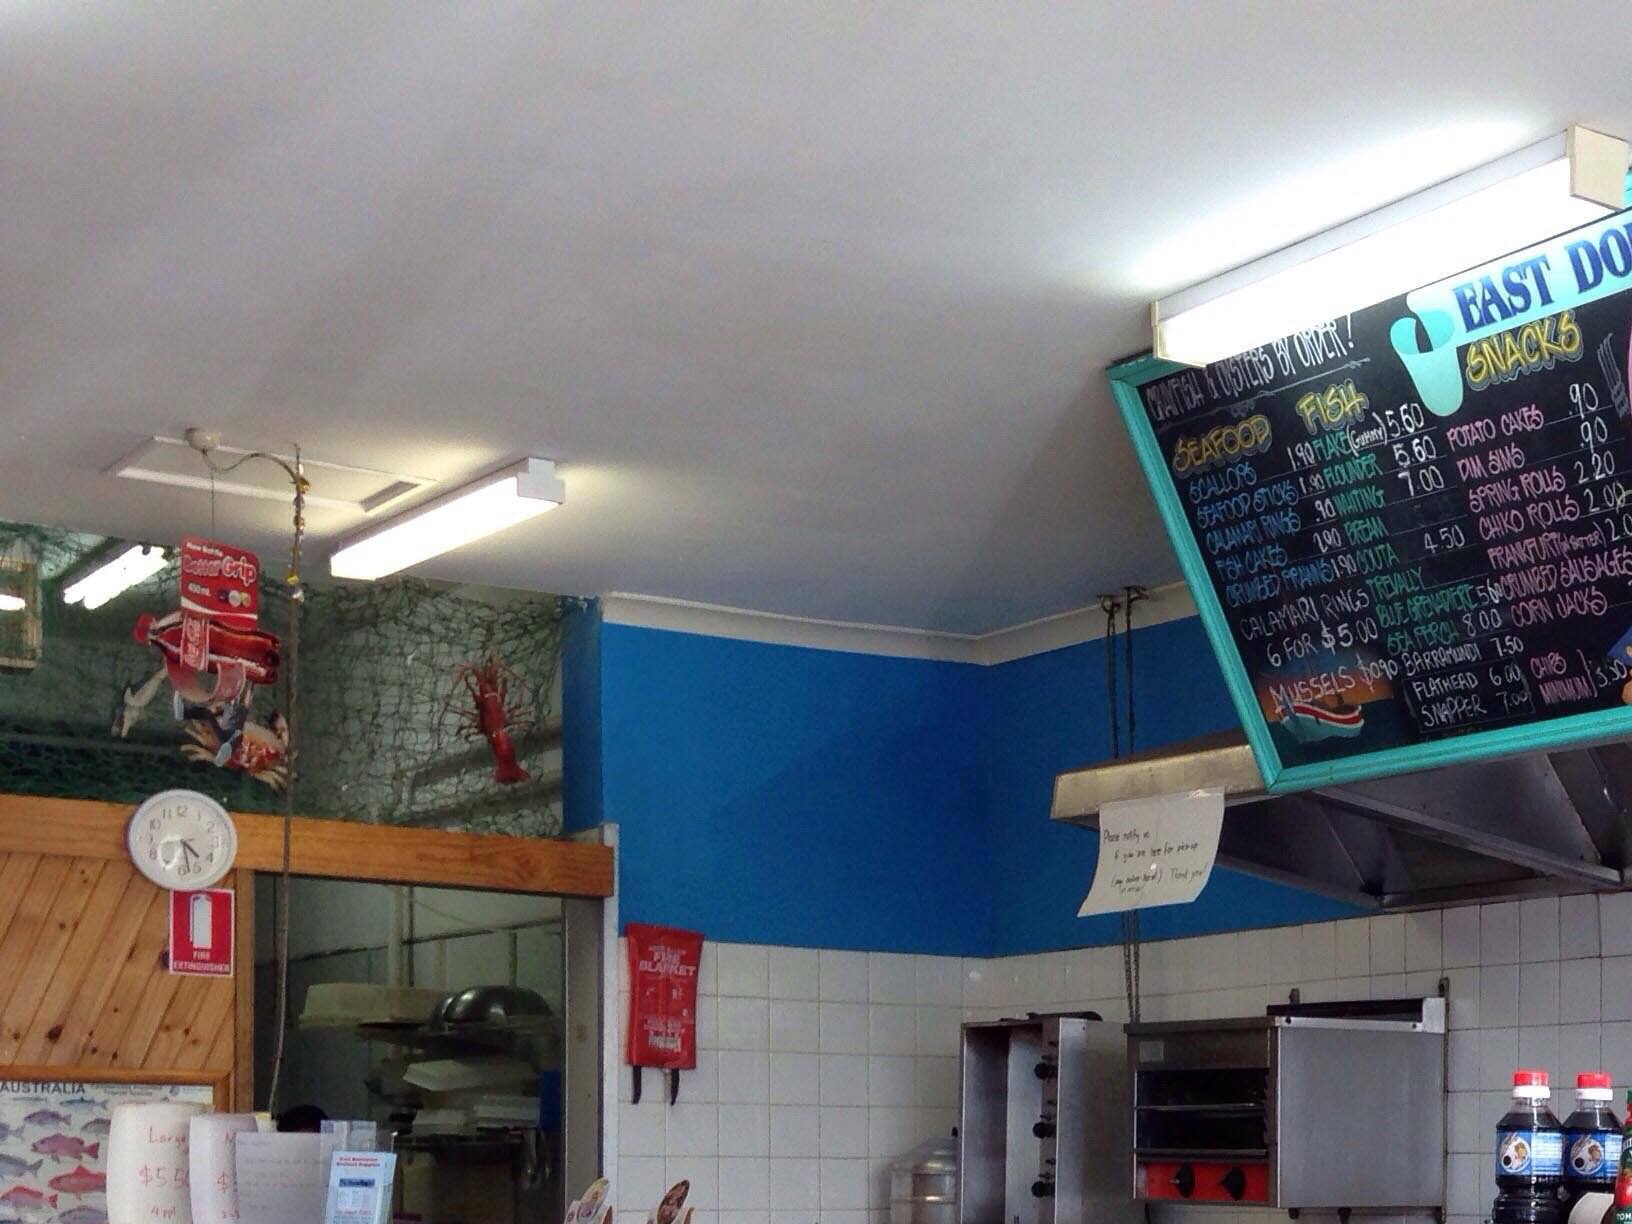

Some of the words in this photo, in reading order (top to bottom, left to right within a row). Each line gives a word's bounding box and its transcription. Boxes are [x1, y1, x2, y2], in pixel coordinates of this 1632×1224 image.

[1453, 256, 1554, 331] EAST
[1216, 347, 1275, 398] OYSTERS
[1272, 337, 1298, 376] BY
[1466, 311, 1583, 391] SNACKS
[1296, 381, 1369, 434] FISH
[1384, 403, 1424, 437] 5.60
[1447, 418, 1496, 451] POTATO
[1500, 403, 1544, 436] CAKES
[1173, 415, 1272, 473] SEAFOOD
[1323, 453, 1382, 488] FLOUNDER
[1393, 433, 1438, 467] 5.60
[1456, 455, 1487, 481] DIM
[1489, 442, 1525, 474] SIMS
[1189, 463, 1257, 503] SCALLOPS
[1468, 479, 1519, 512] SPRING
[1521, 466, 1565, 499] ROLLS
[1574, 450, 1615, 484] 2.20
[1479, 509, 1524, 540] CHIKO
[1527, 494, 1580, 529] ROLLS
[1240, 597, 1318, 640] CALAMARI
[1321, 588, 1370, 620] RINGS
[1511, 600, 1550, 628] CORN
[1557, 588, 1607, 619] JACKS
[1267, 643, 1281, 667] 6
[1283, 633, 1317, 660] FOR
[1530, 652, 1567, 679] CHIPS
[1269, 666, 1356, 713] MUSSELS
[1413, 670, 1478, 700] FLATHEAD
[1421, 694, 1486, 726] SNAPPER
